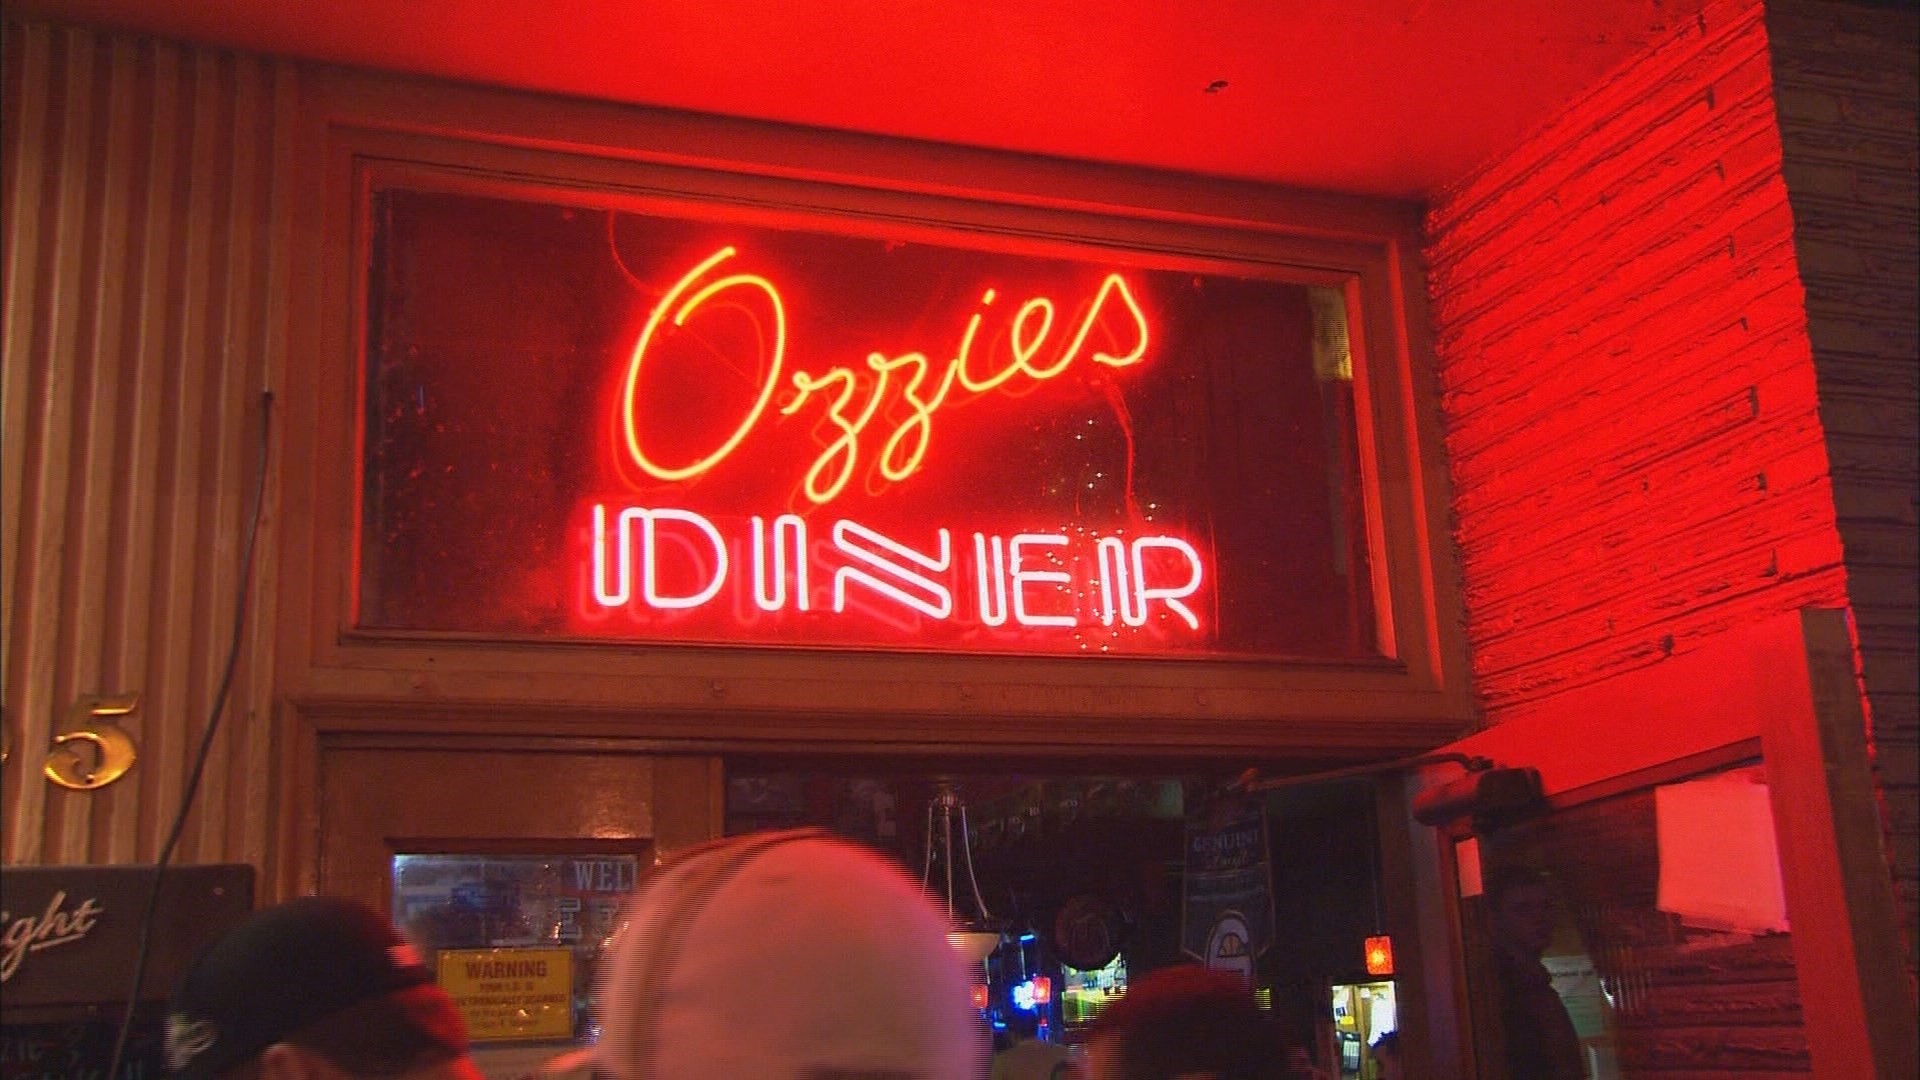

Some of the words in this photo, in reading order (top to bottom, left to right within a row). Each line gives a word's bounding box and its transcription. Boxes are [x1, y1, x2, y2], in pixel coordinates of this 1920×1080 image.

[624, 246, 1150, 504] Ozzies
[591, 504, 1204, 629] DINER
[0, 694, 138, 789] 5
[1192, 828, 1260, 852] GENUIN
[466, 960, 548, 978] WARNING
